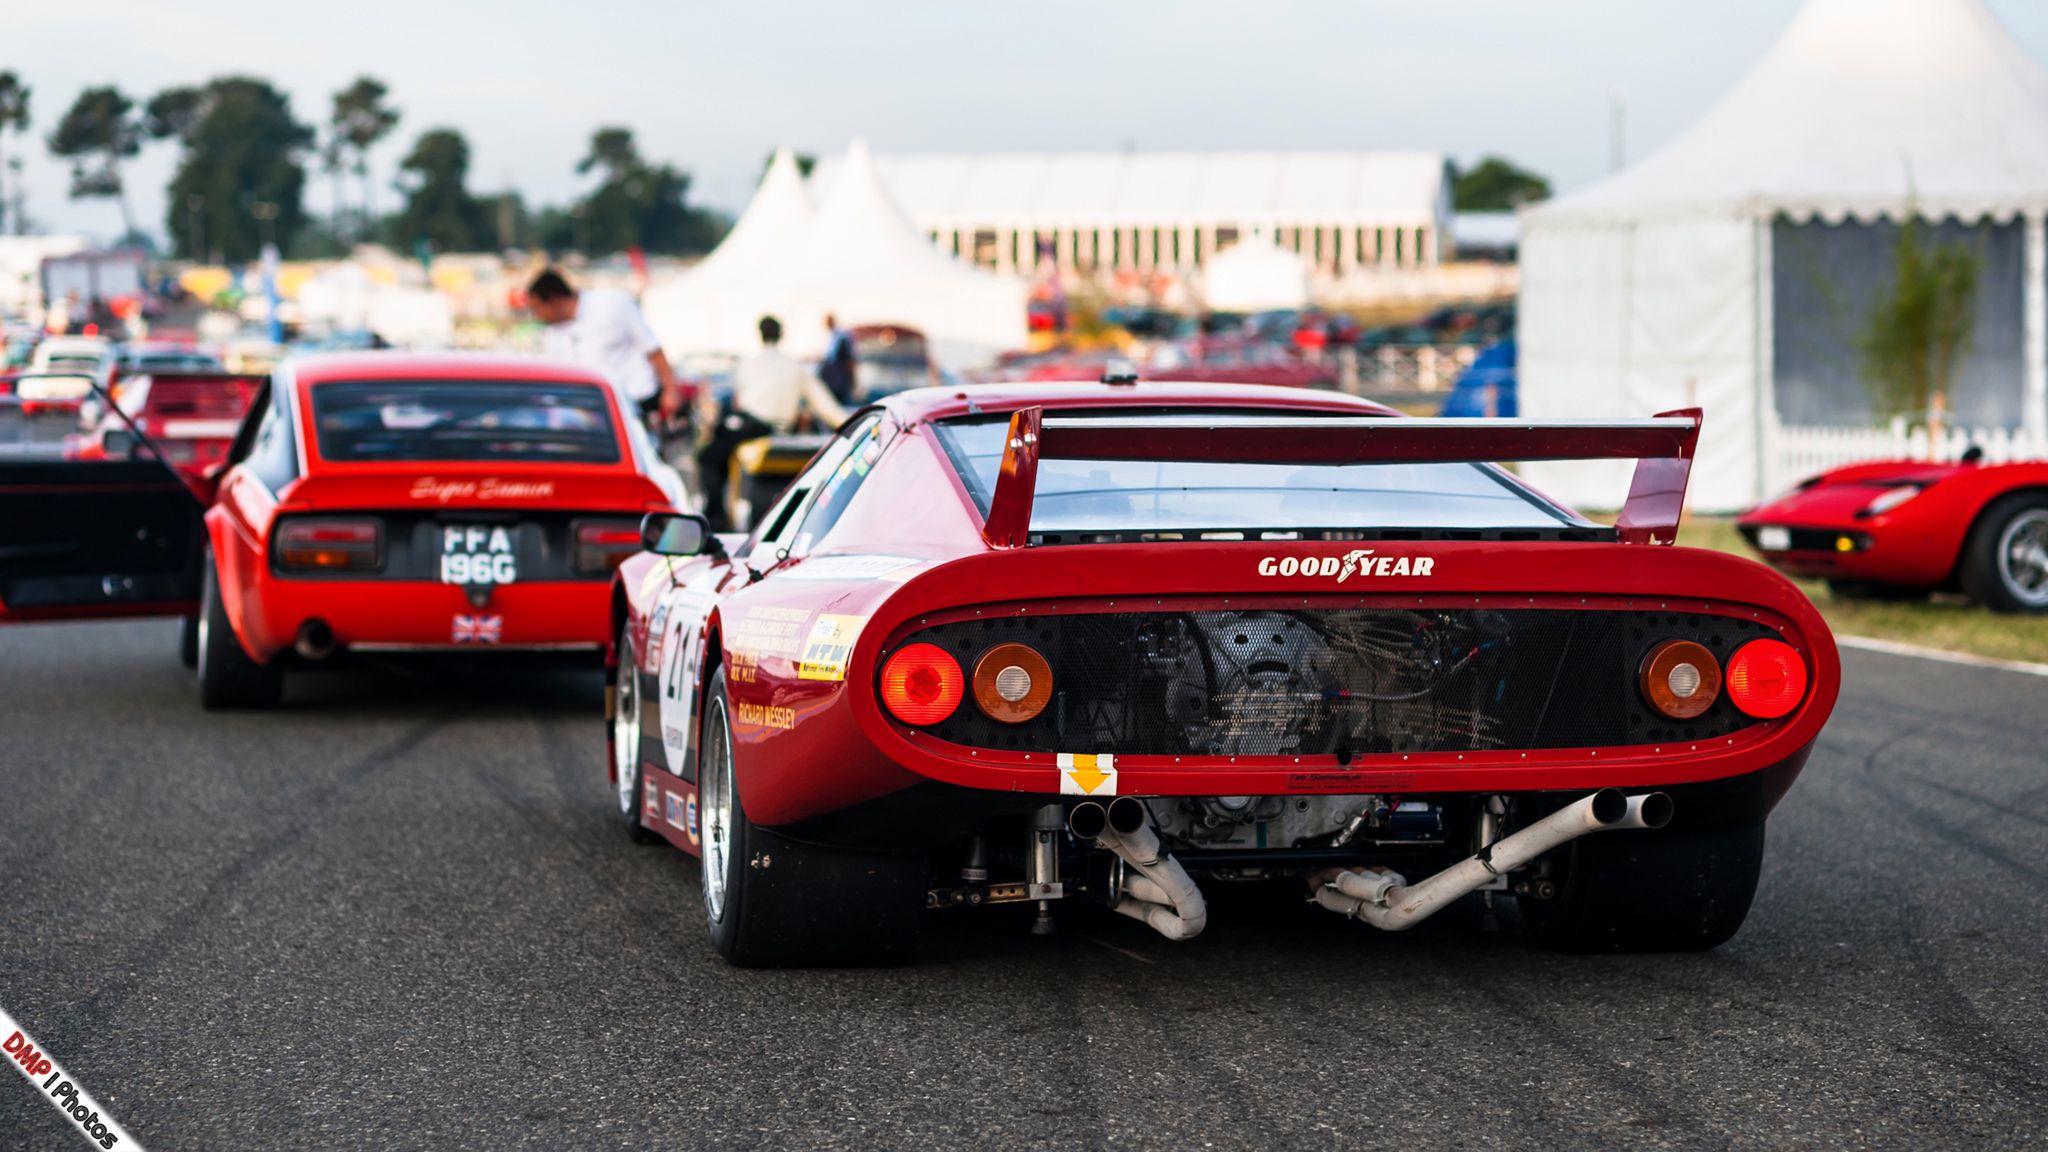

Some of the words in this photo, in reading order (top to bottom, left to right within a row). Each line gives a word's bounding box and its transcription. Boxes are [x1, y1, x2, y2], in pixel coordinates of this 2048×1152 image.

[443, 525, 511, 553] FFA
[440, 552, 516, 585] 196G
[738, 702, 764, 726] RICHARD
